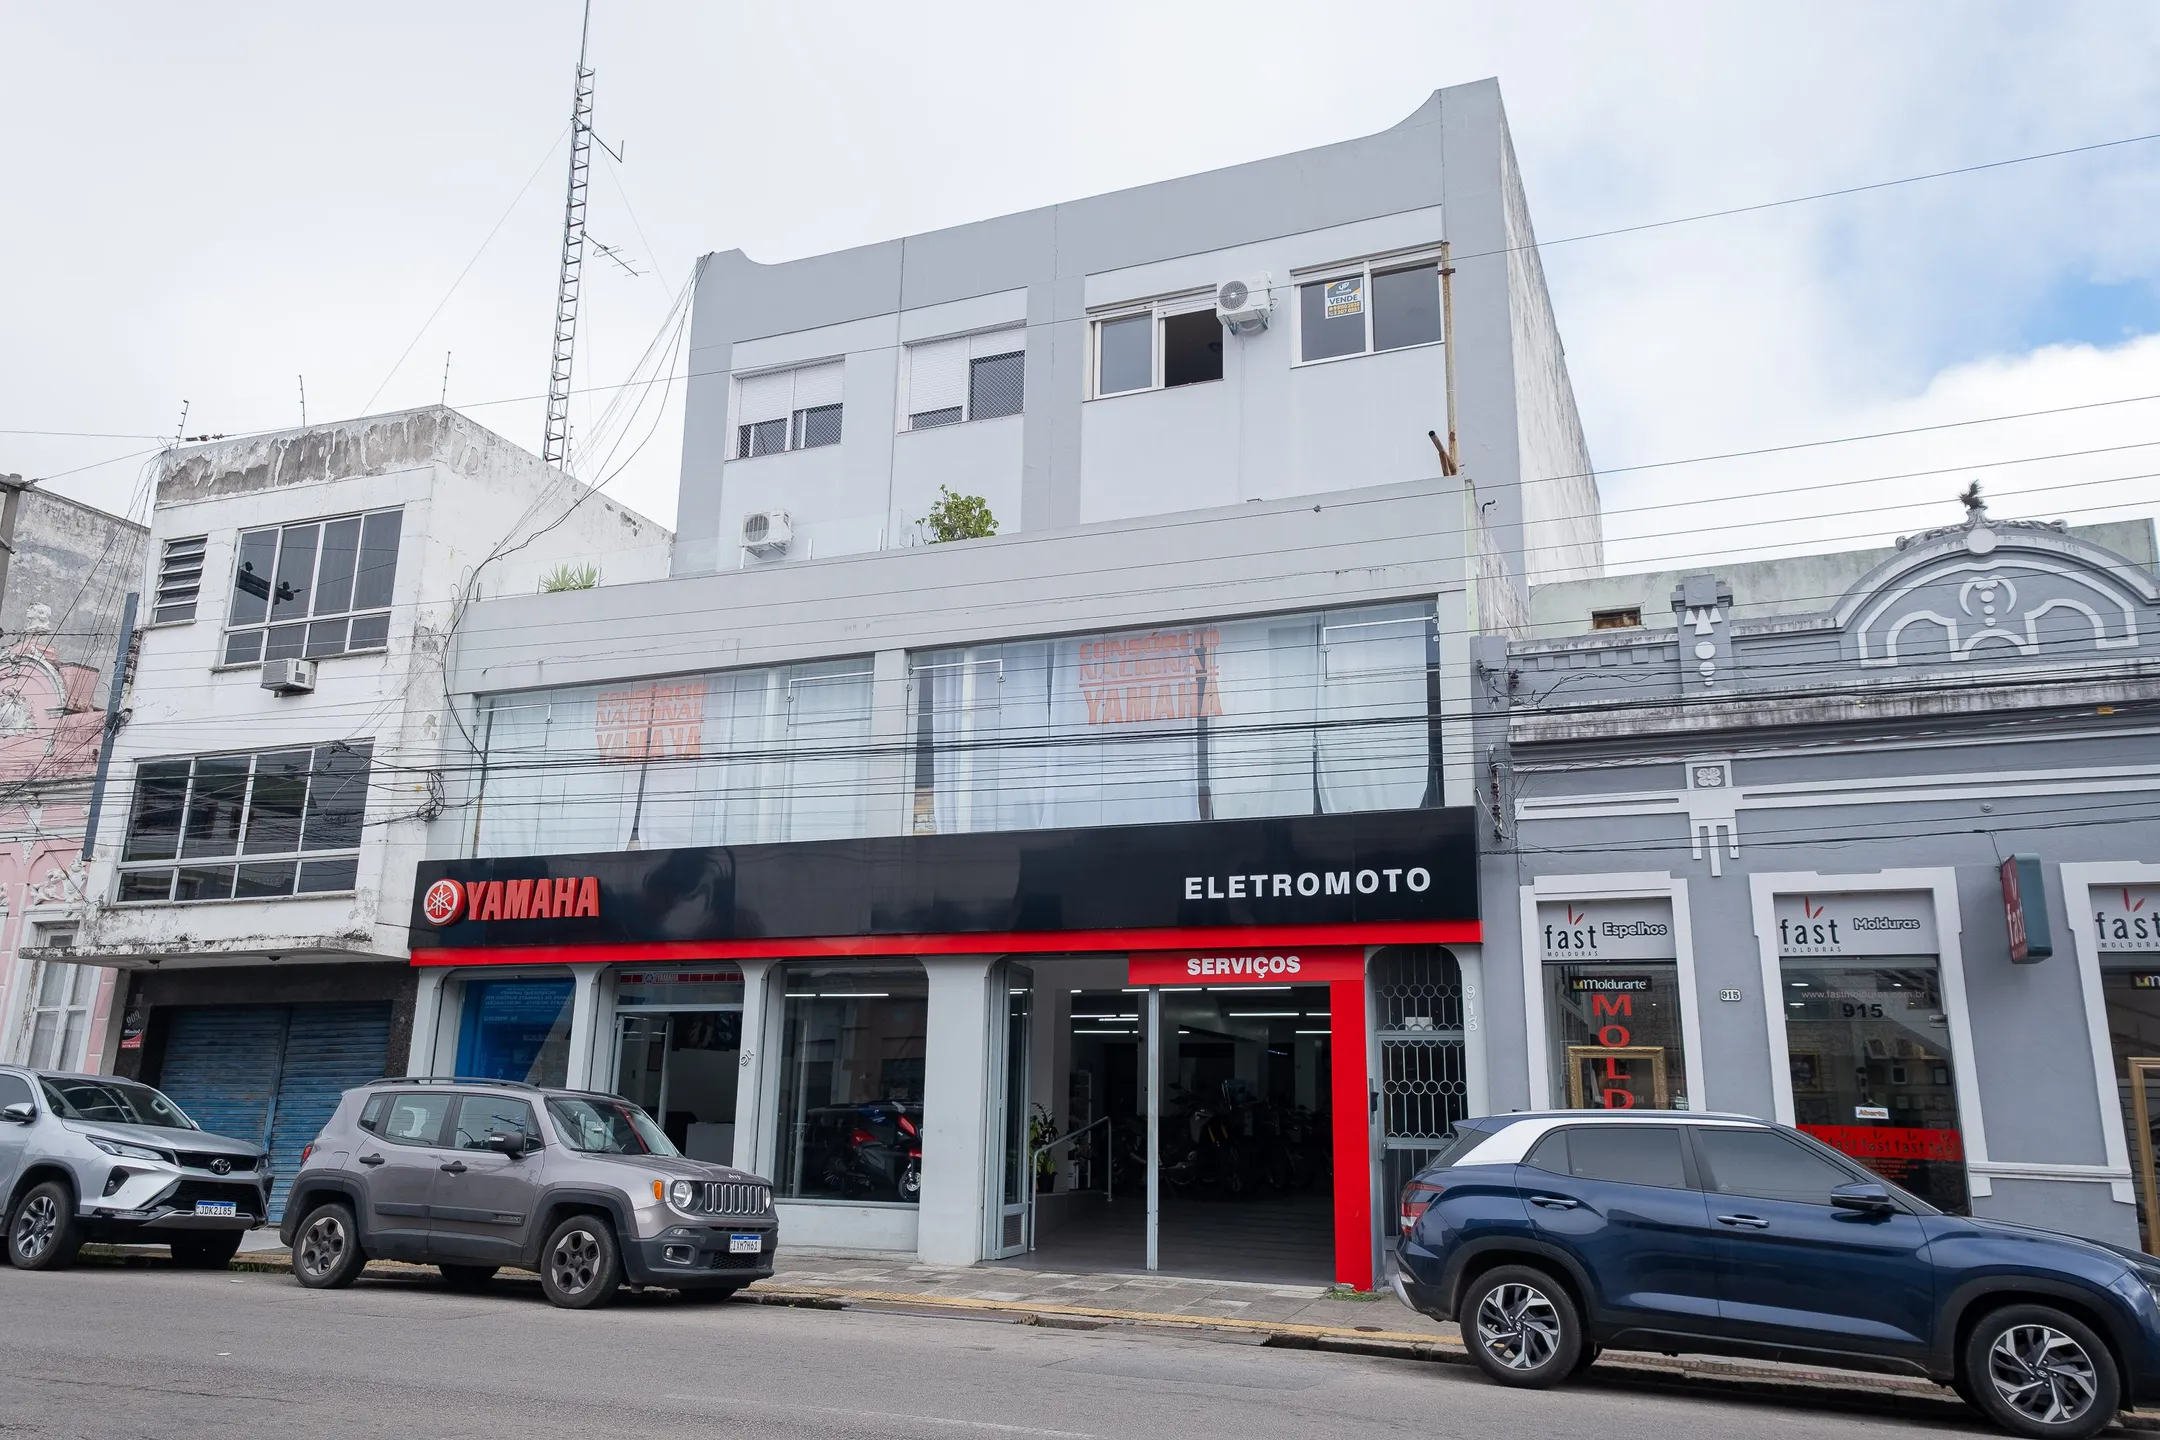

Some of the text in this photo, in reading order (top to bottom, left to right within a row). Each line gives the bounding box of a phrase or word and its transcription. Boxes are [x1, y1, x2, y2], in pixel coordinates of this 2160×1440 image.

[1329, 294, 1358, 305] VENDE
[1079, 631, 1220, 660] CONSÓRCIO
[1079, 654, 1219, 681] NACIONAL
[595, 702, 704, 726] NACIONAL
[1083, 679, 1223, 725] YAMAHA
[1185, 867, 1431, 900] ELETROMOTO
[466, 876, 600, 921] YAMAHA
[1602, 921, 1668, 939] Espelhos
[1780, 918, 1840, 945] fast
[1852, 916, 1921, 931] Molduras
[2006, 898, 2027, 947] fast
[2095, 911, 2160, 940] fast
[1544, 924, 1598, 949] fast
[1187, 956, 1301, 979] SERVIÇOS
[1721, 991, 1740, 1000] 915
[126, 1010, 142, 1027] 909
[1466, 985, 1478, 1032] 913
[1841, 1003, 1884, 1018] 915
[740, 1049, 755, 1067] 911
[1895, 1140, 1925, 1153] fast
